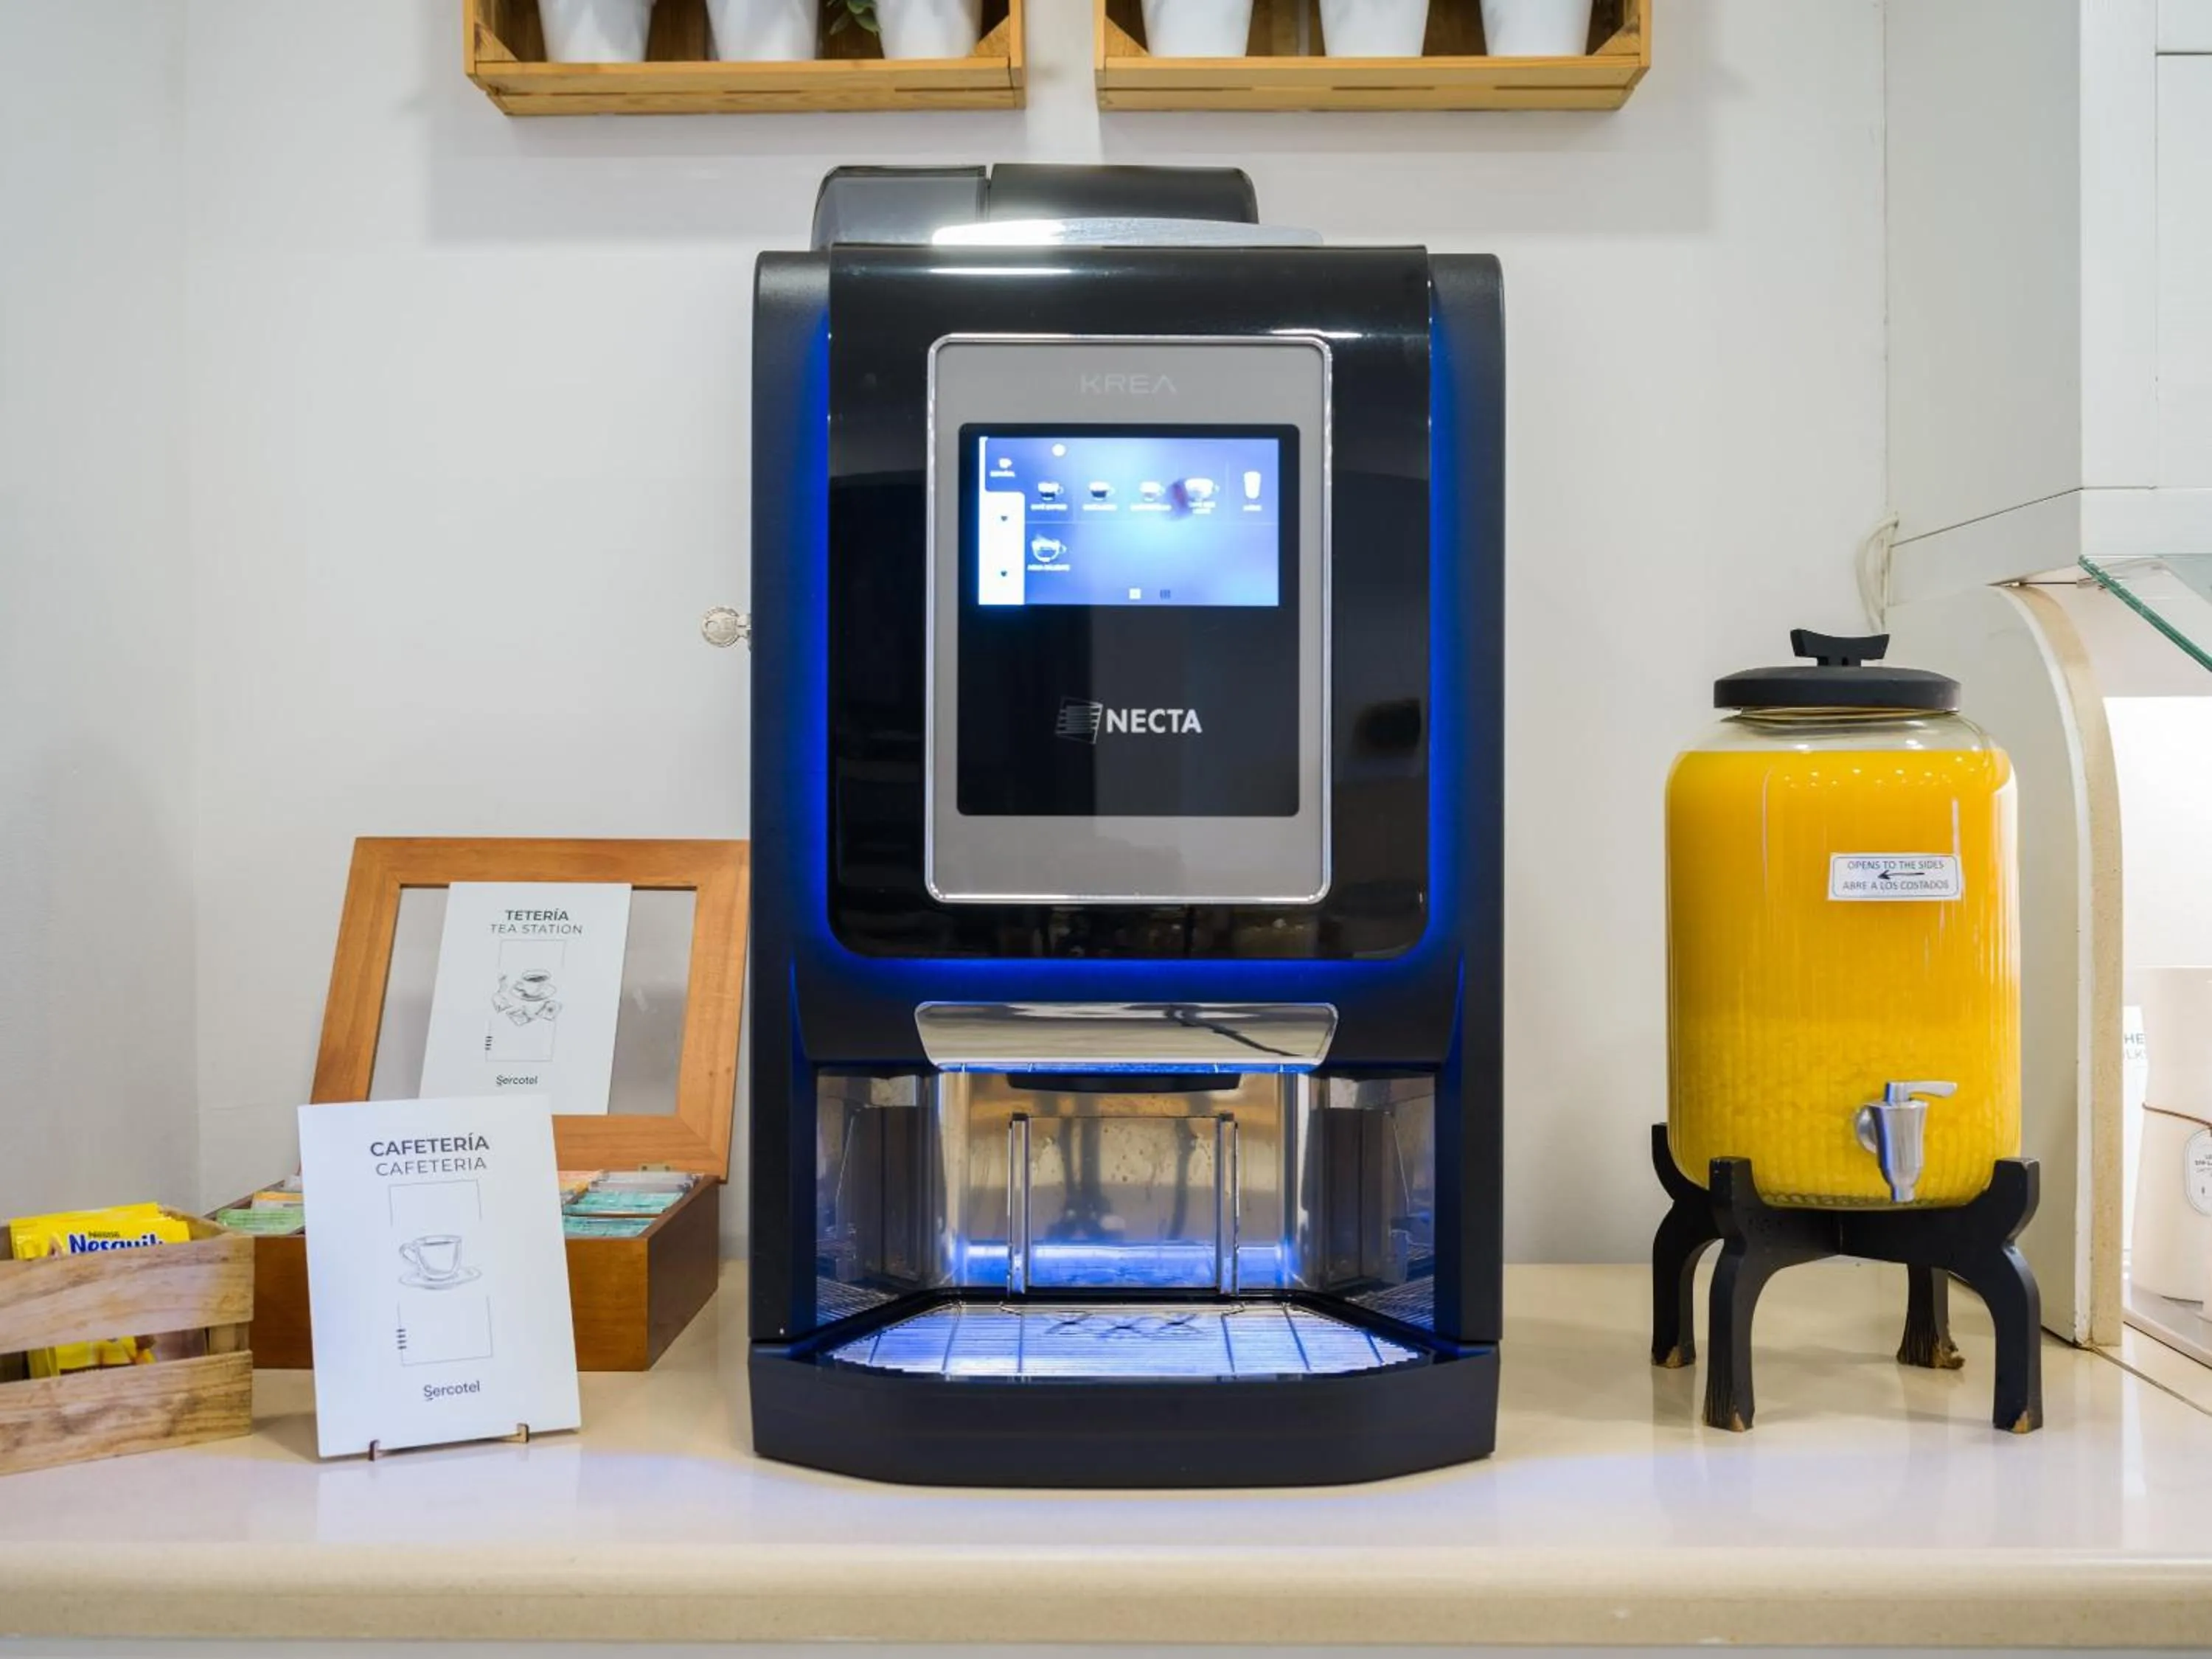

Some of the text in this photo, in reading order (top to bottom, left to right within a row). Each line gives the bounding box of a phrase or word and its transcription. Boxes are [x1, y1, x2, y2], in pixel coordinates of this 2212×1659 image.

[1080, 374, 1178, 394] KREA
[1106, 708, 1203, 734] NECTA
[1847, 860, 1944, 870] OPENS TO THE SIDES
[1843, 880, 1949, 891] ABRE A LOS COSTADOS
[505, 908, 569, 921] TETERÍA
[490, 923, 583, 935] TEA STATION
[370, 1132, 490, 1157] CAFETERÍA
[376, 1157, 487, 1177] CAFETERIA
[423, 1380, 481, 1402] Sercotel
